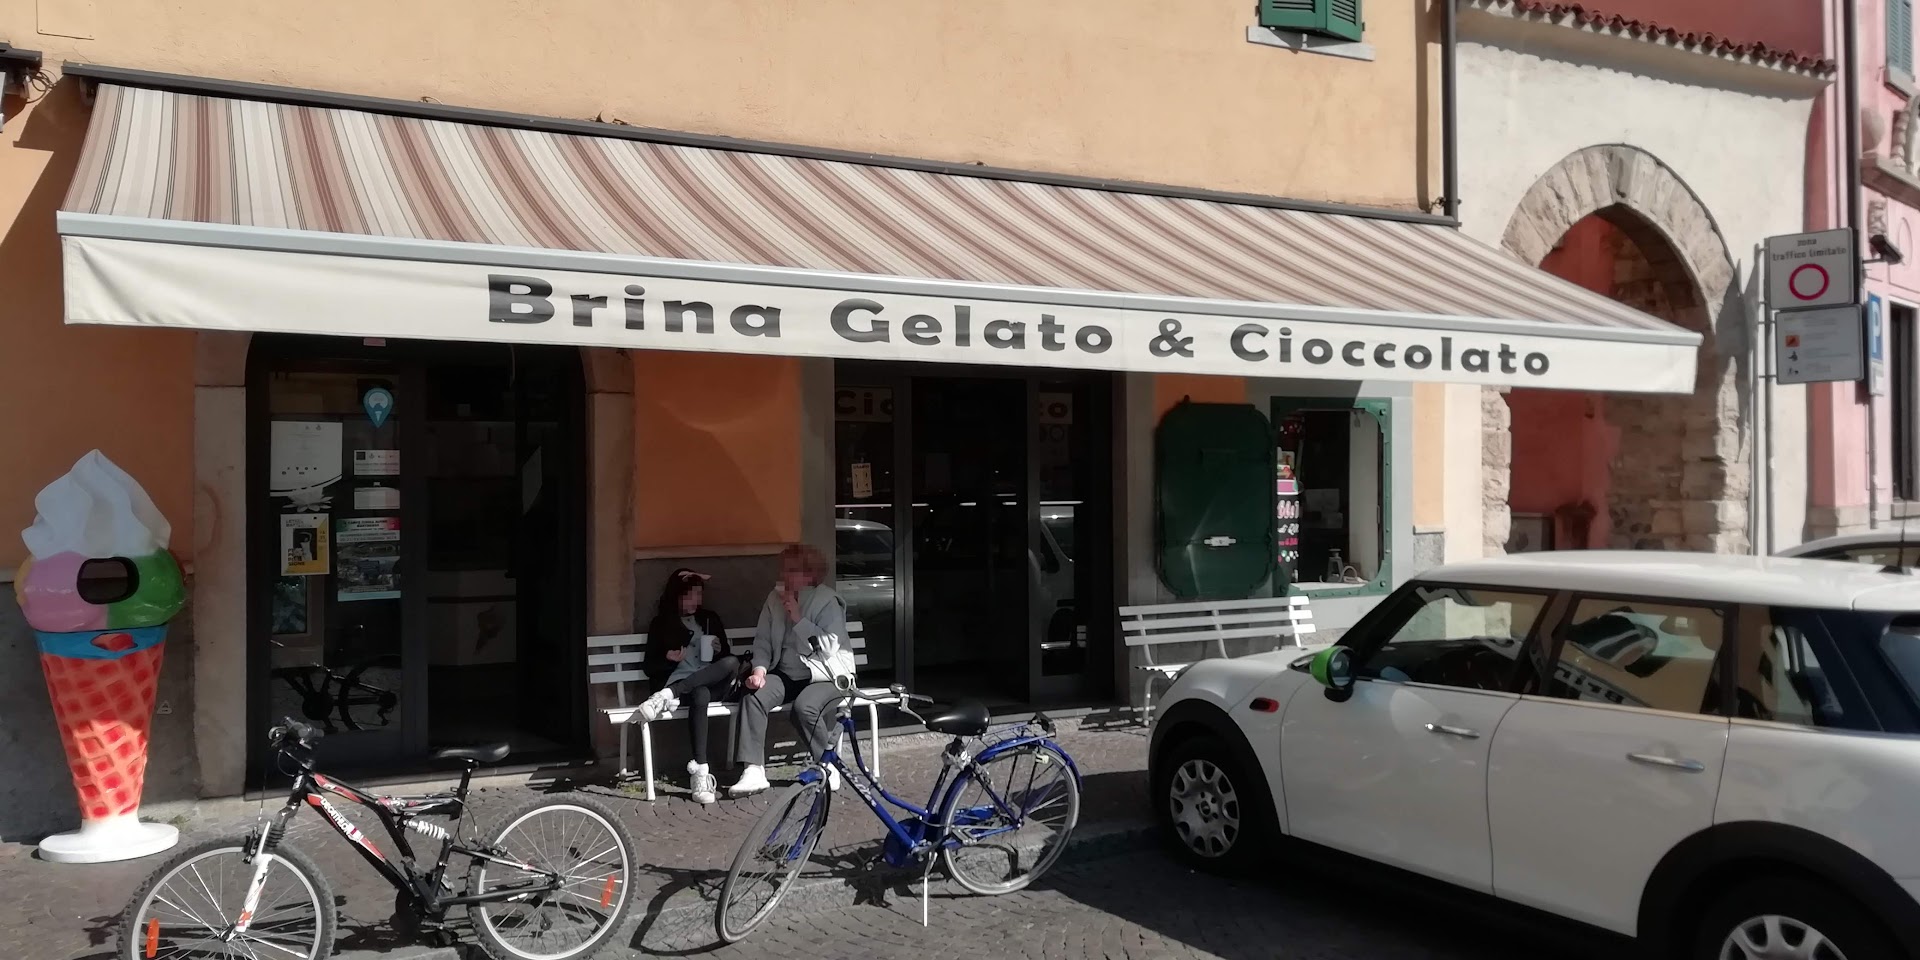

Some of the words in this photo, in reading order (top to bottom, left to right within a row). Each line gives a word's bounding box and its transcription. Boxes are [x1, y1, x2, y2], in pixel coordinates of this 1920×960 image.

[1772, 249, 1807, 261] traffico
[1809, 246, 1847, 257] limitato
[1797, 238, 1817, 246] zona
[487, 273, 782, 338] Brina
[829, 298, 1113, 354] Gelato
[1148, 318, 1194, 358] &
[1229, 323, 1550, 376] Cioccolato
[320, 798, 352, 836] DECATHLON
